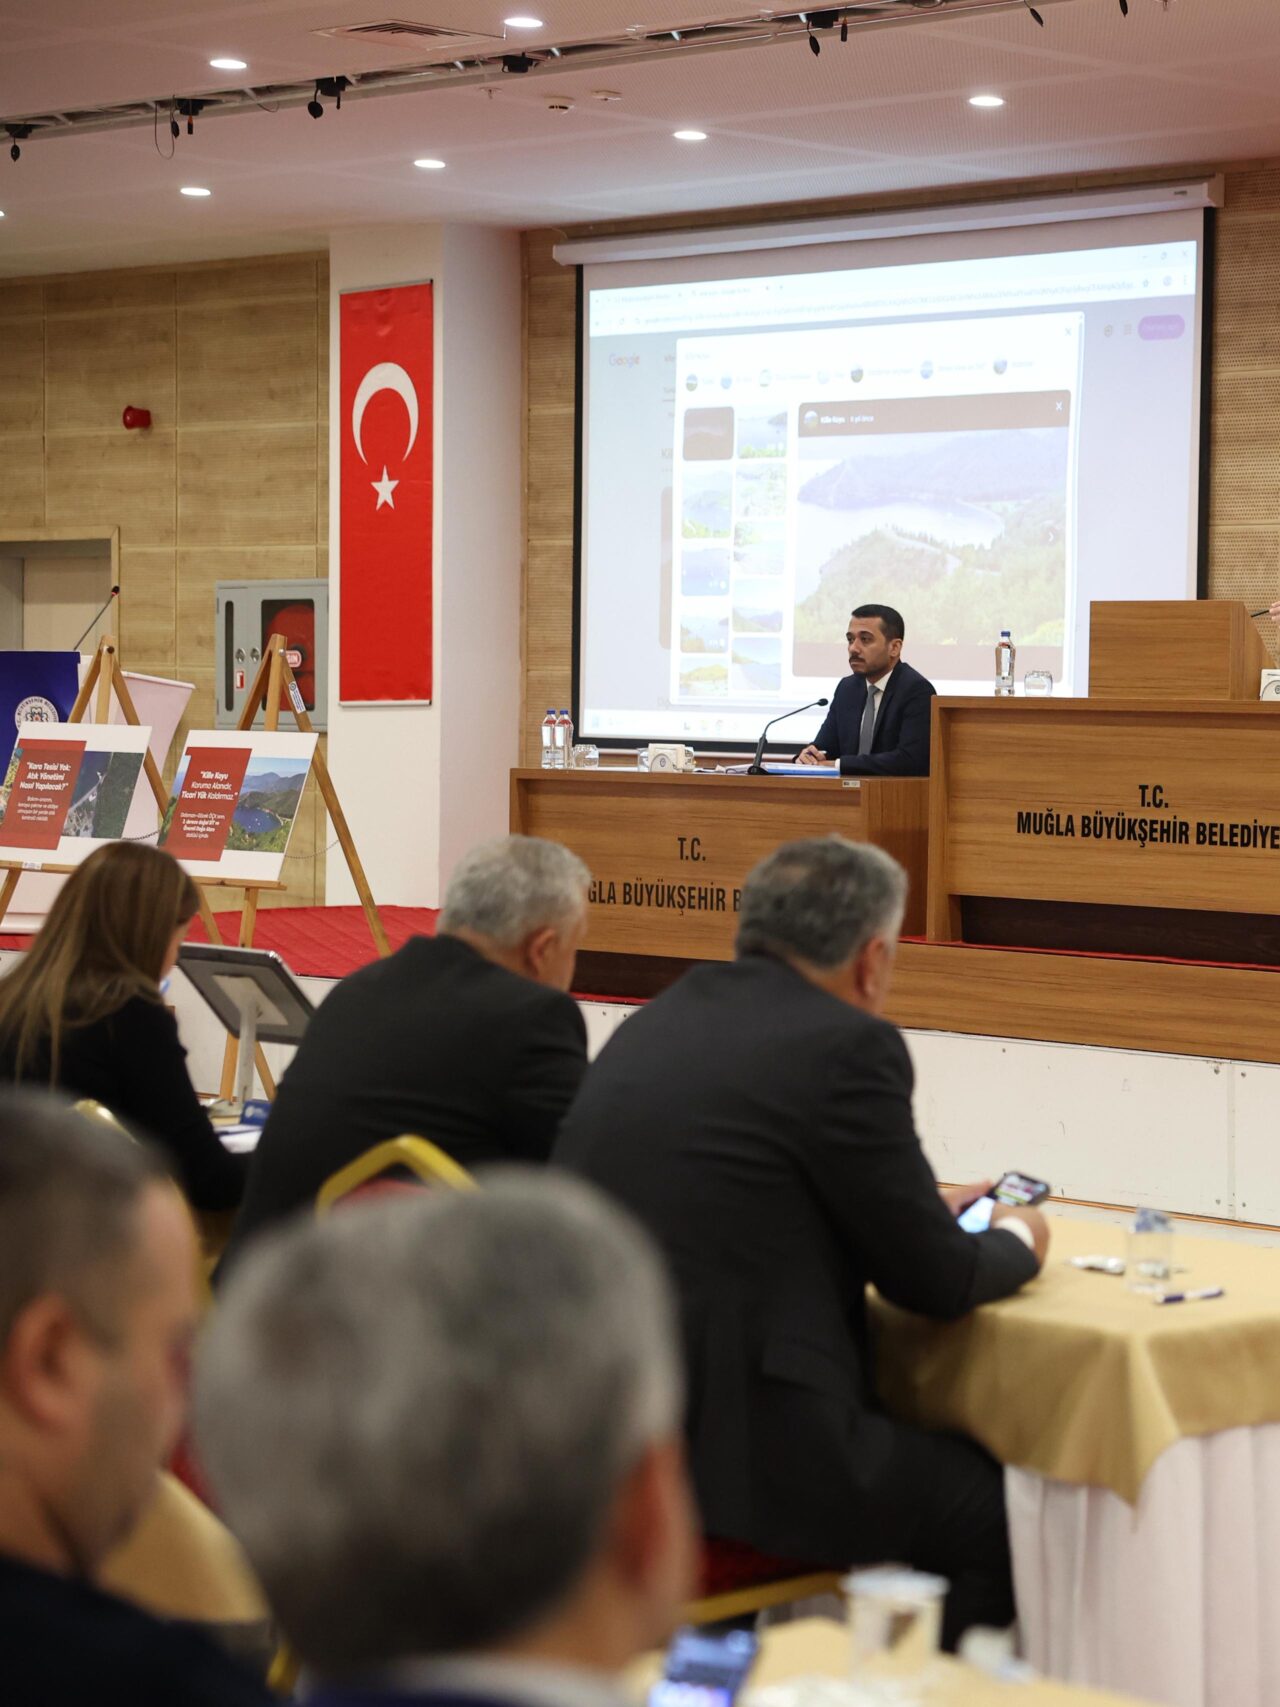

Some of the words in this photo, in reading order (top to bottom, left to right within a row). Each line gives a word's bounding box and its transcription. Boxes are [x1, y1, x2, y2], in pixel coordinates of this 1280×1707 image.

[1138, 784, 1169, 808] T.C.
[1016, 808, 1075, 837] MUĞLA
[1081, 810, 1189, 847] BÜYÜKŞEHİR
[677, 837, 706, 862] T.C.
[588, 880, 616, 904] GLA
[622, 878, 726, 916] BÜYÜKŞEHİR
